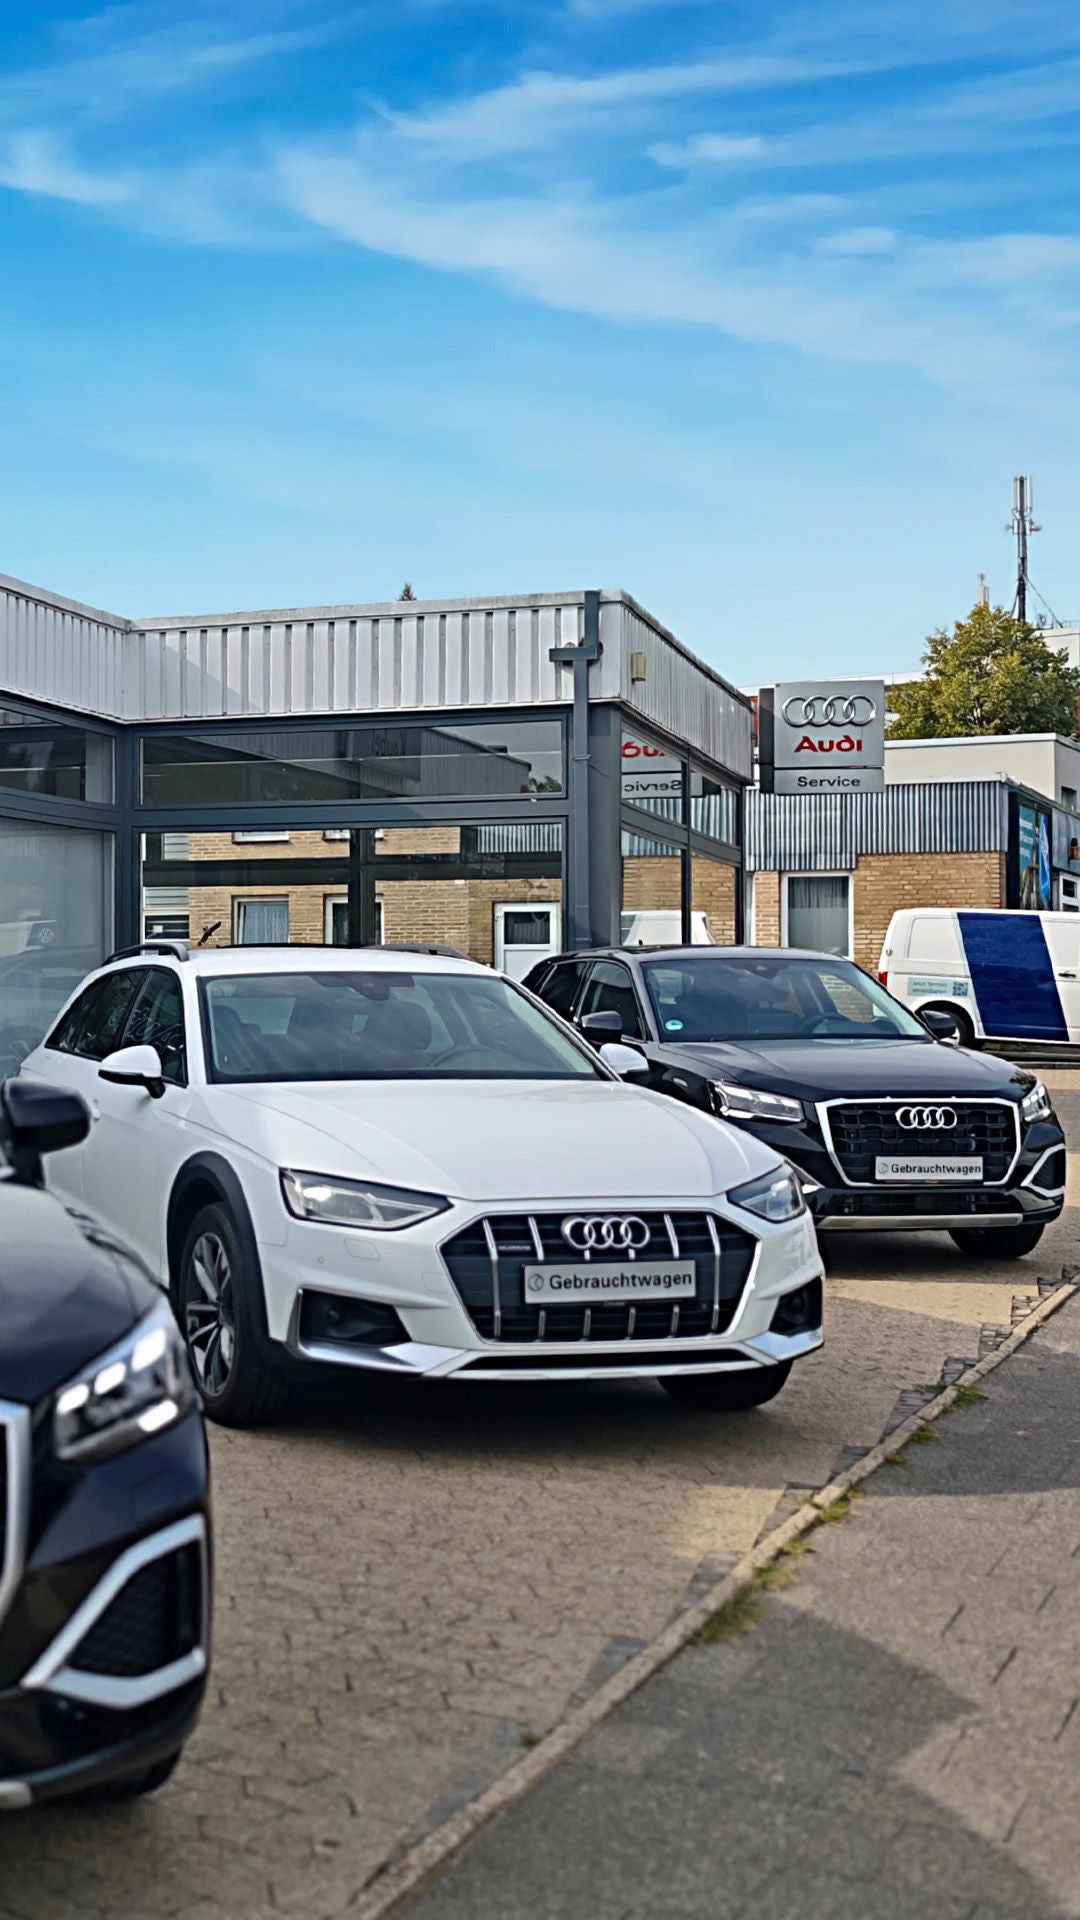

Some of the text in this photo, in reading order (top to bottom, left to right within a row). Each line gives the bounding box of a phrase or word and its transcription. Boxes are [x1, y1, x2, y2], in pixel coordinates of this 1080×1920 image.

[794, 735, 862, 752] Audi
[797, 776, 860, 787] Service
[891, 1164, 982, 1175] Gebrauchtwagen
[549, 1273, 692, 1290] Gebrauchtwagen
